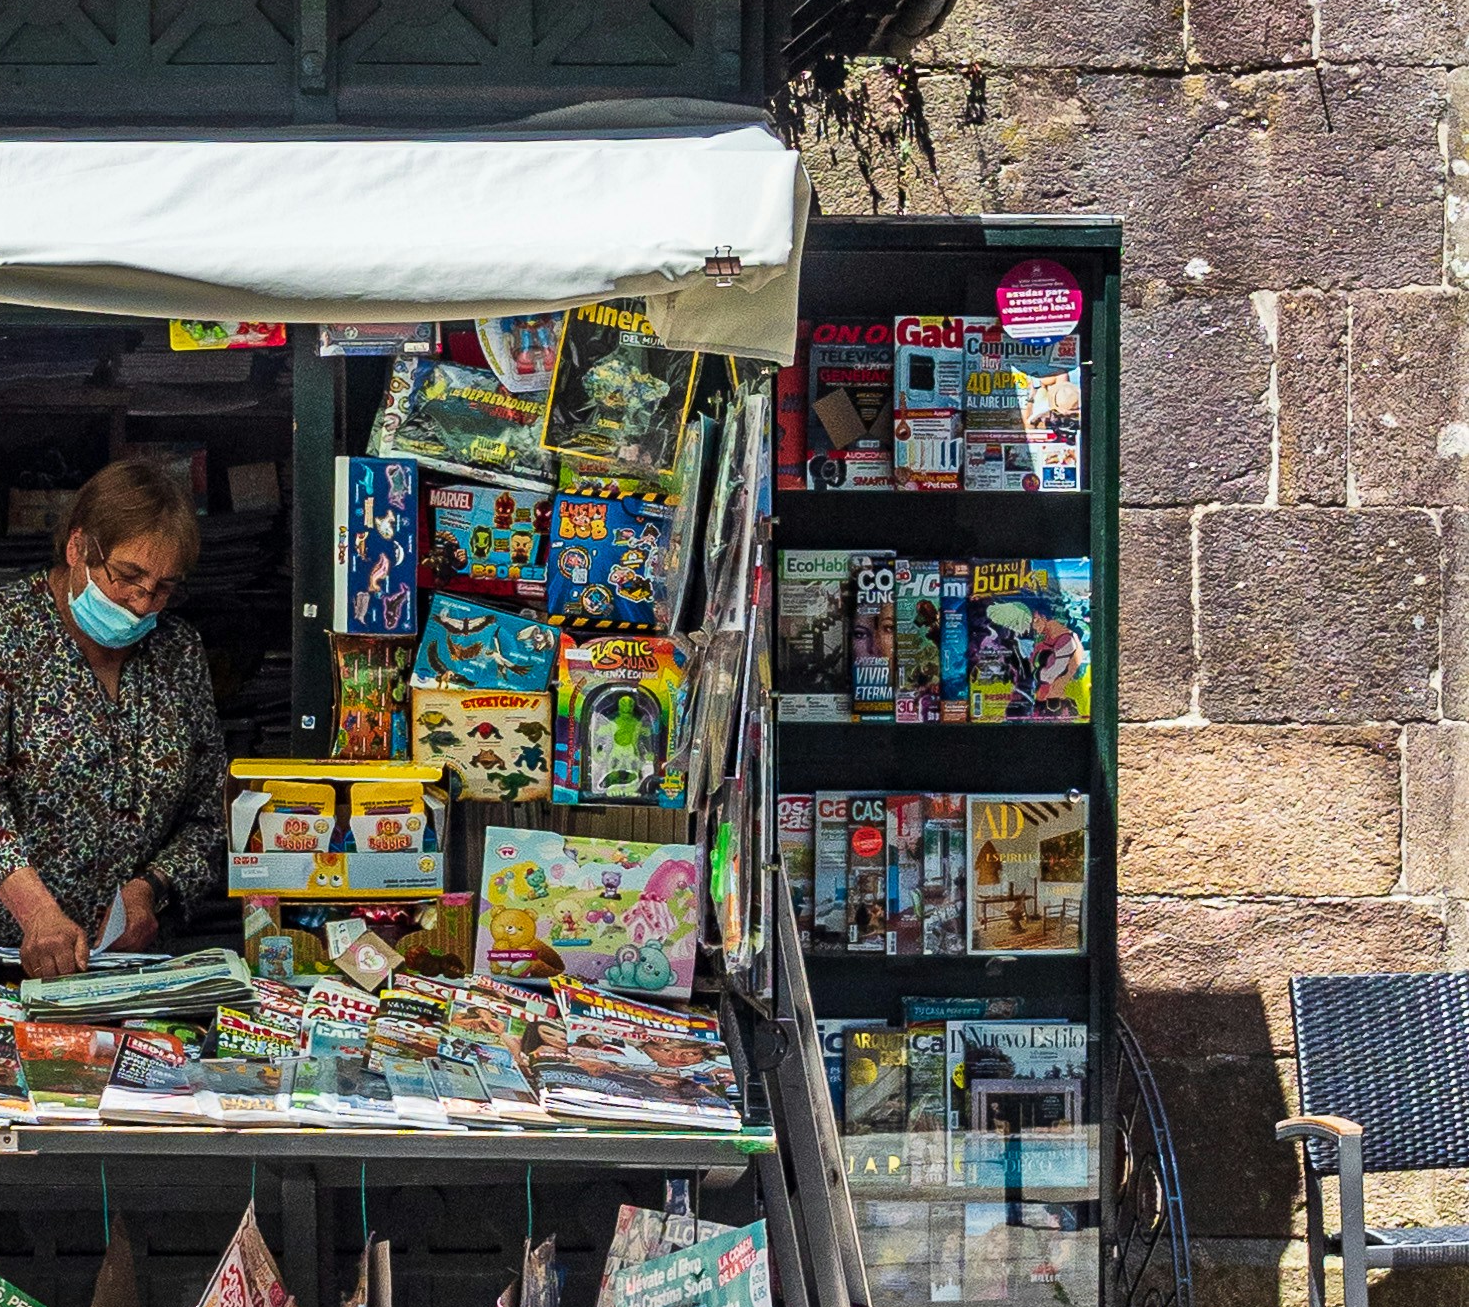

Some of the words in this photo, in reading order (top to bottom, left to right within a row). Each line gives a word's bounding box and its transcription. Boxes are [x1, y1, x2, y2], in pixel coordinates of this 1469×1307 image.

[1002, 305, 1049, 314] comercio
[1051, 302, 1076, 311] local
[813, 324, 861, 343] ON
[864, 324, 894, 343] O
[967, 337, 1047, 359] Computer
[982, 355, 1000, 370] Hoy
[967, 371, 991, 395] 40
[993, 371, 1028, 390] APPS
[462, 387, 546, 414] DEPREDADORES
[967, 396, 978, 408] AL
[980, 396, 1000, 408] AIRE
[430, 490, 473, 509] MARVEL
[560, 501, 607, 523] LUCKY
[559, 518, 608, 540] BOB
[974, 559, 1048, 594] bunka
[981, 562, 1018, 574] OTAKU
[590, 640, 652, 666] ELASTIC
[855, 667, 890, 685] VIVIR
[461, 696, 529, 710] STRETCHY
[897, 700, 914, 714] 30
[852, 800, 885, 822] CAS
[975, 803, 1025, 840] AD
[966, 1027, 1027, 1049] Nuevo
[1030, 1027, 1085, 1048] Estilo
